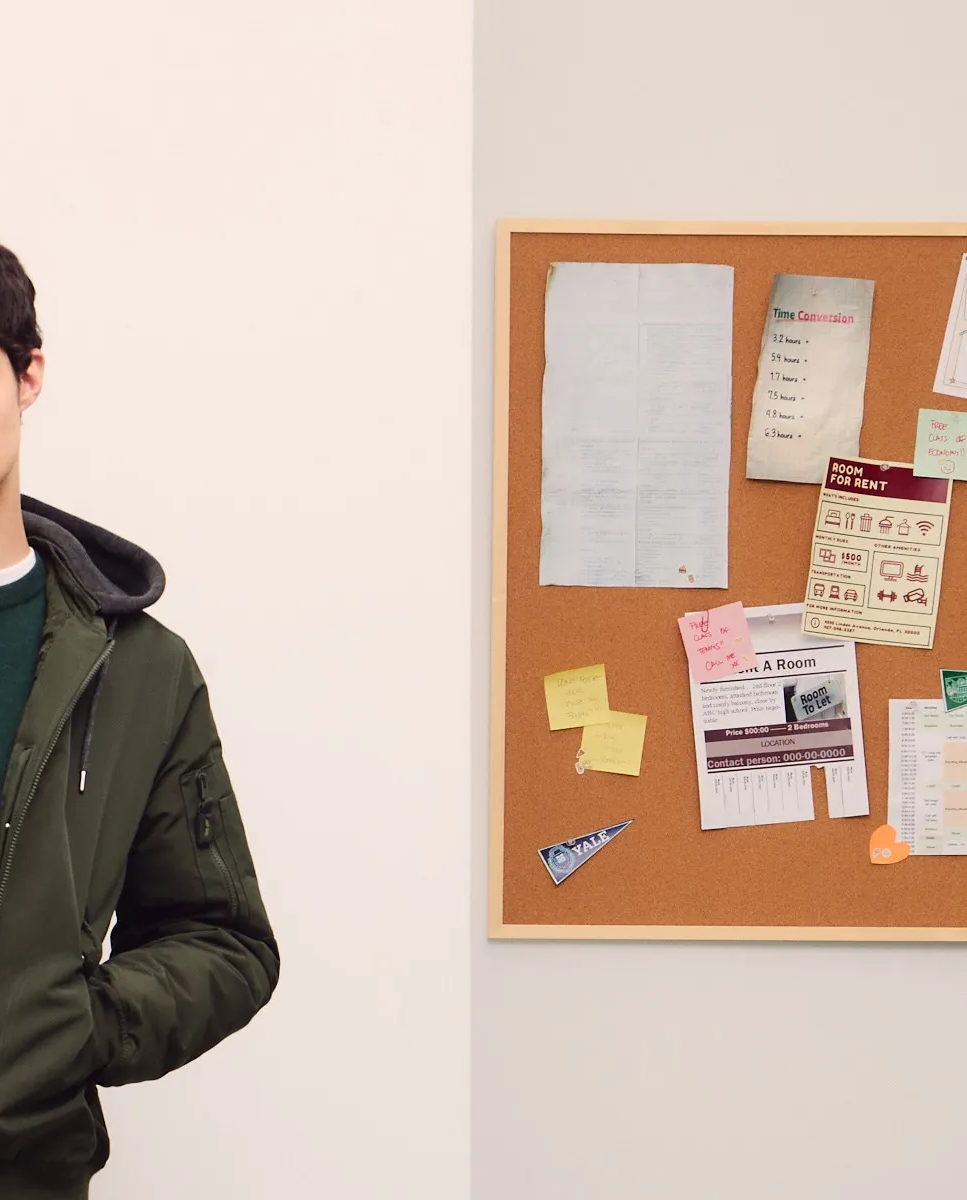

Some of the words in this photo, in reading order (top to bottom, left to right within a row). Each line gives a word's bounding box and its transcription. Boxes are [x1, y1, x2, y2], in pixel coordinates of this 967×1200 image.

[773, 308, 796, 320] Time
[797, 310, 854, 324] Conversion
[785, 336, 801, 345] hours
[783, 355, 800, 364] hours
[782, 374, 798, 382] hours
[780, 393, 796, 402] hours
[778, 411, 795, 420] hours
[777, 430, 793, 439] hours
[832, 462, 864, 477] ROOM
[830, 473, 851, 487] FOR
[854, 477, 888, 491] RENT
[841, 552, 862, 562] $500
[811, 569, 851, 579] TRANSPORTATION
[829, 607, 863, 615] INFORMATION
[763, 660, 773, 672] A
[776, 658, 817, 671] Room
[800, 685, 829, 705] Room
[802, 703, 815, 716] To
[817, 694, 832, 709] Let
[725, 729, 743, 737] Price
[744, 726, 769, 736] $00:00
[793, 721, 829, 730] Bedrooms
[760, 738, 796, 748] LOCATION
[707, 756, 745, 769] Contact
[746, 754, 781, 766] person:
[783, 747, 846, 762] 000-00-0000
[572, 830, 610, 856] YALE
